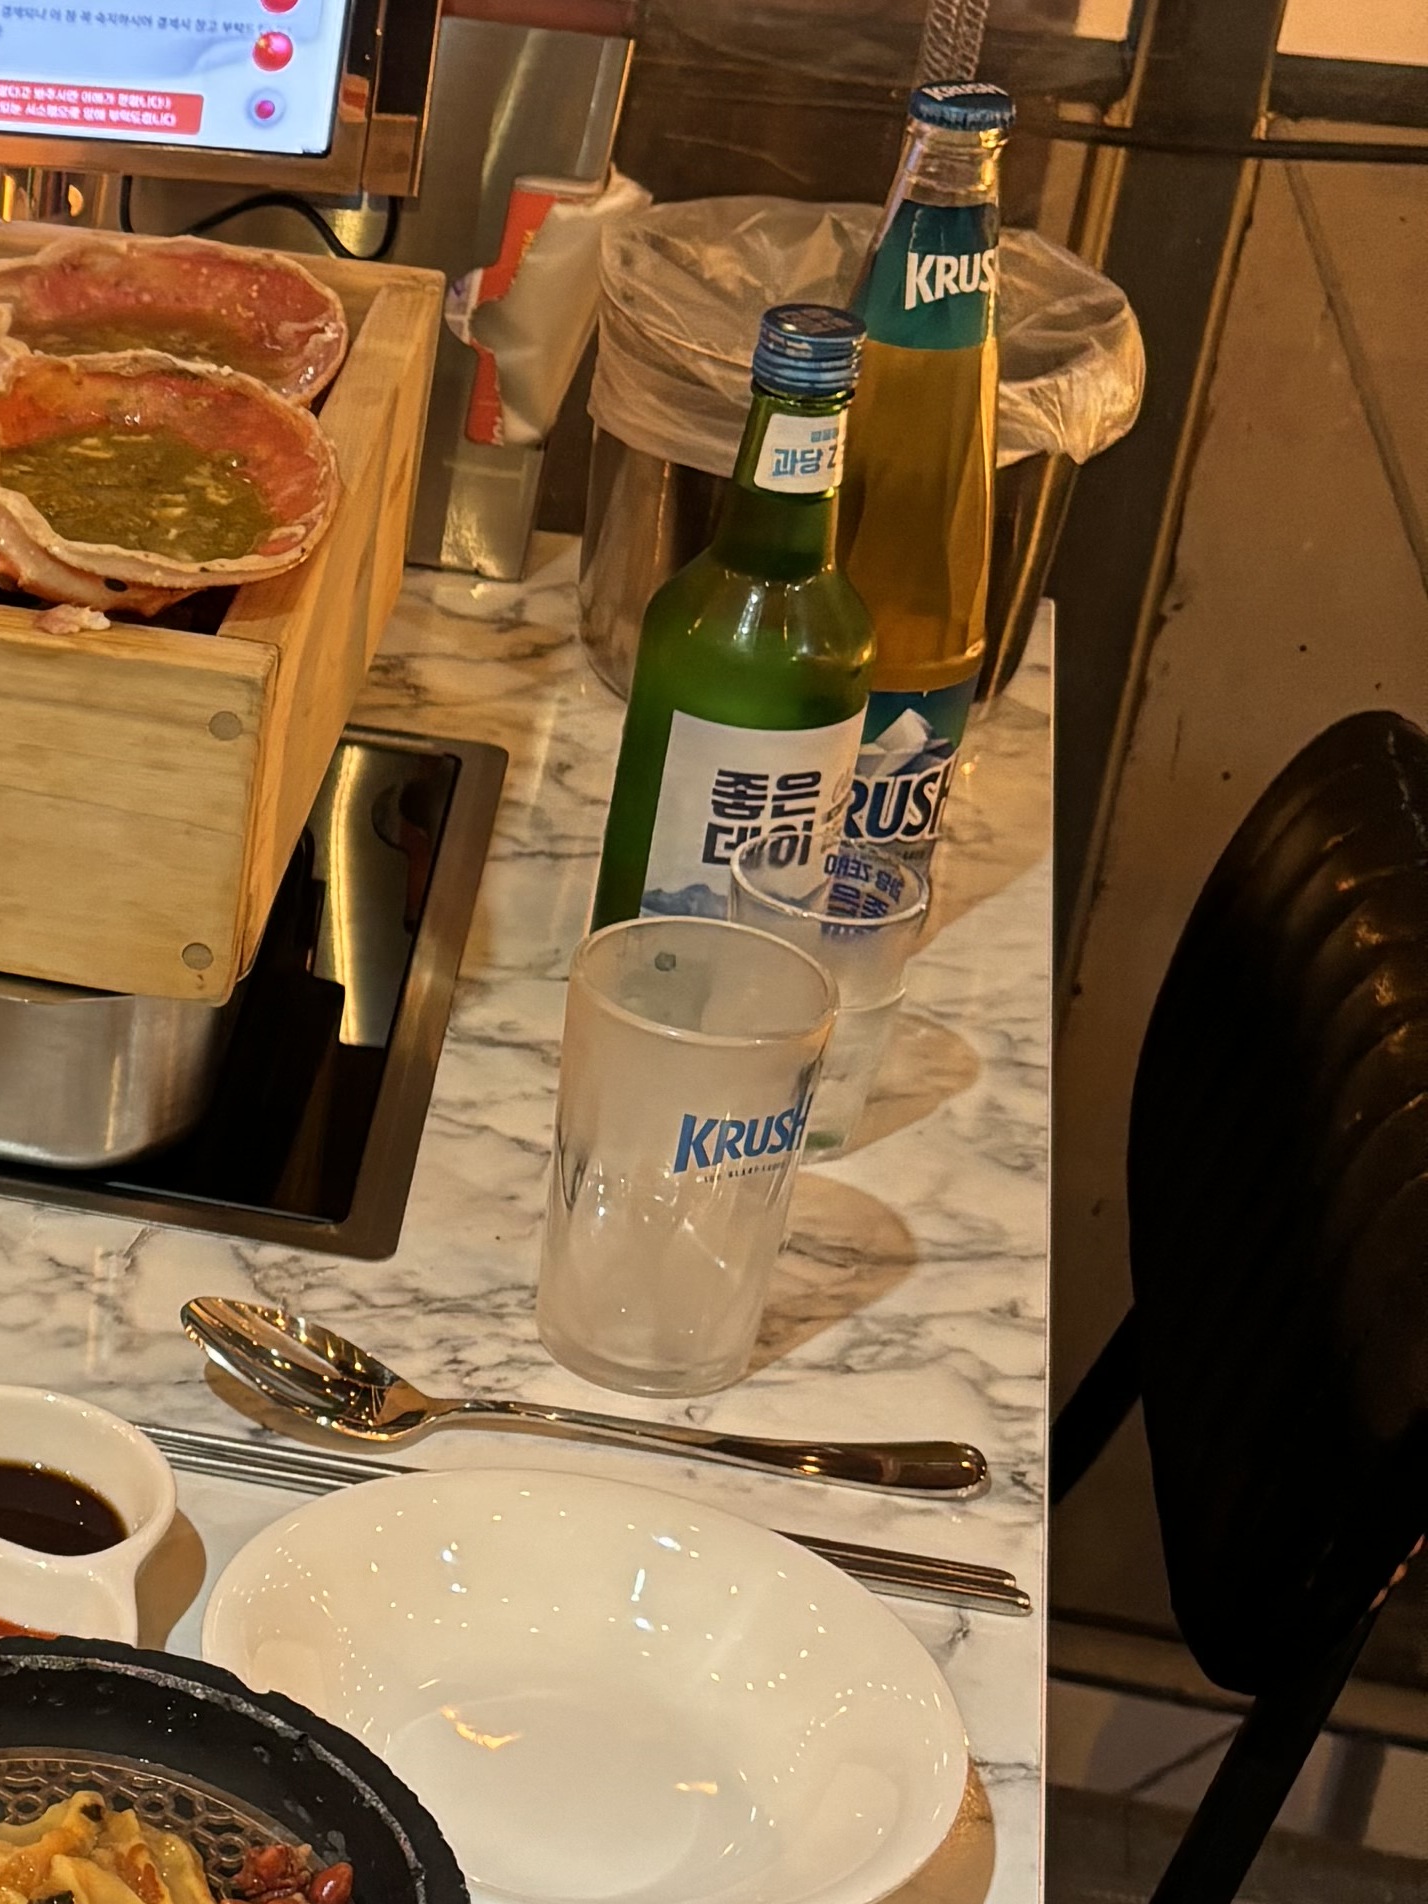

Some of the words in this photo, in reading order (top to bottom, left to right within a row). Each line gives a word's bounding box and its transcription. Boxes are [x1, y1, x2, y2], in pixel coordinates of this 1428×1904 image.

[904, 249, 1000, 310] KRUS
[772, 447, 823, 476] 과당
[711, 768, 821, 821] 좋은
[844, 760, 957, 839] RUSH
[702, 820, 814, 868] 데이
[673, 1096, 811, 1174] KRUSH
